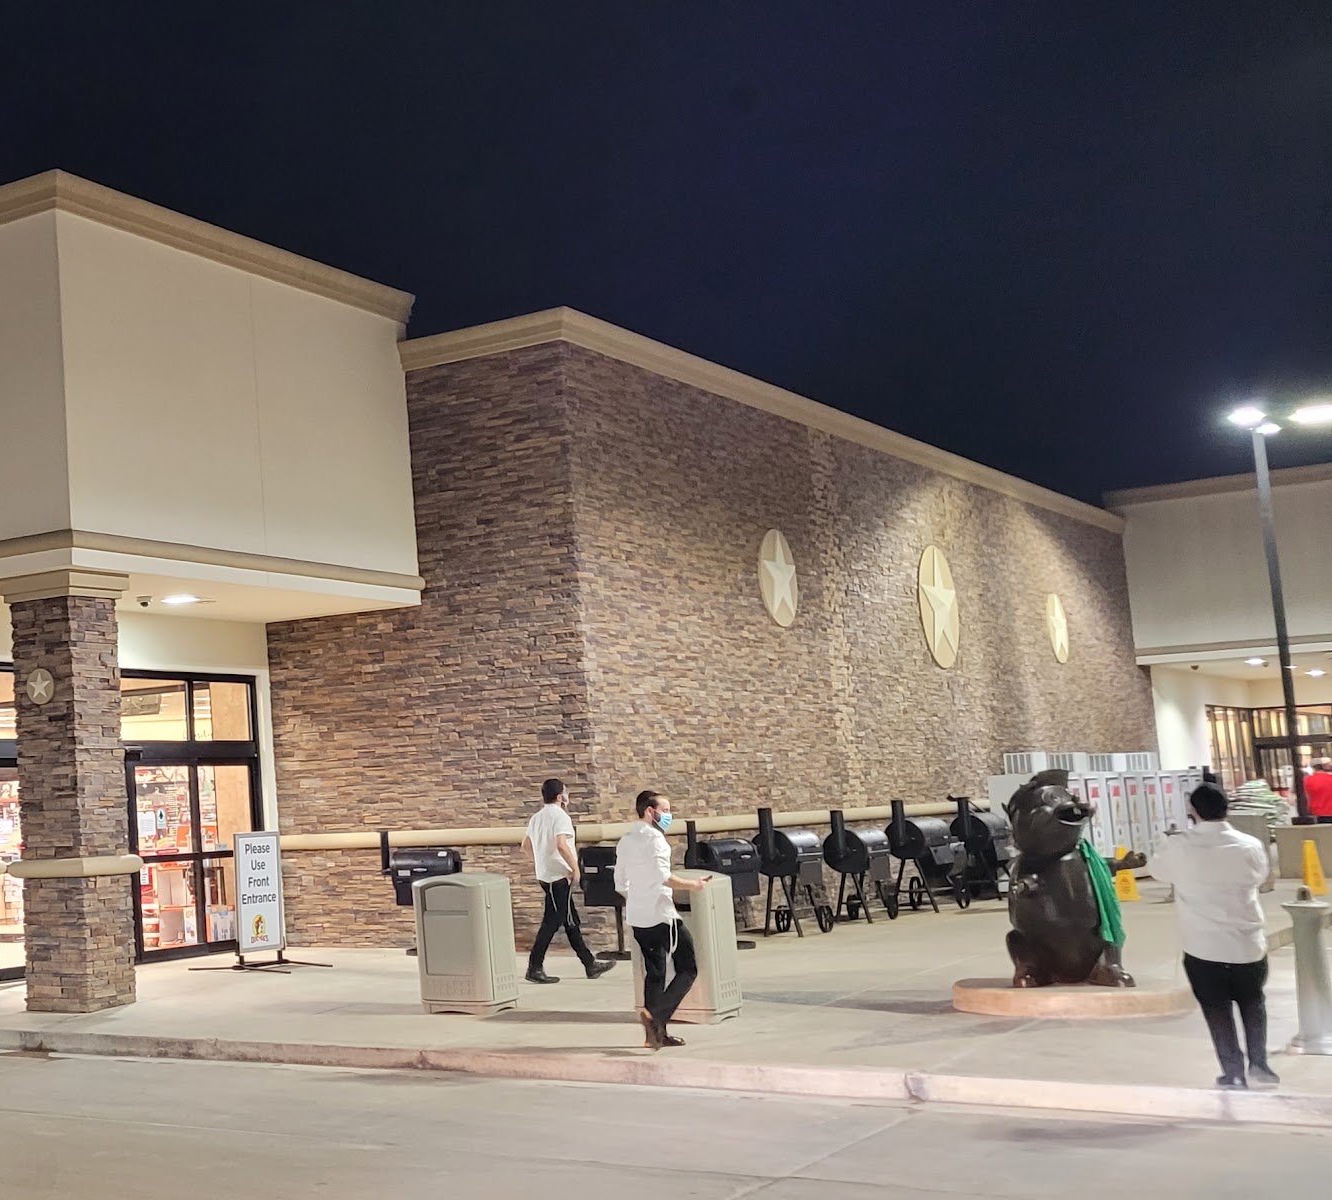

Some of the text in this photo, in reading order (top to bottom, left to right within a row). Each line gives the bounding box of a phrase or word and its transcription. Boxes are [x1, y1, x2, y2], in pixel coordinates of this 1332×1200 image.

[245, 843, 270, 854] Please
[251, 859, 266, 870] Use
[248, 876, 269, 888] Front
[242, 893, 276, 905] Entrance
